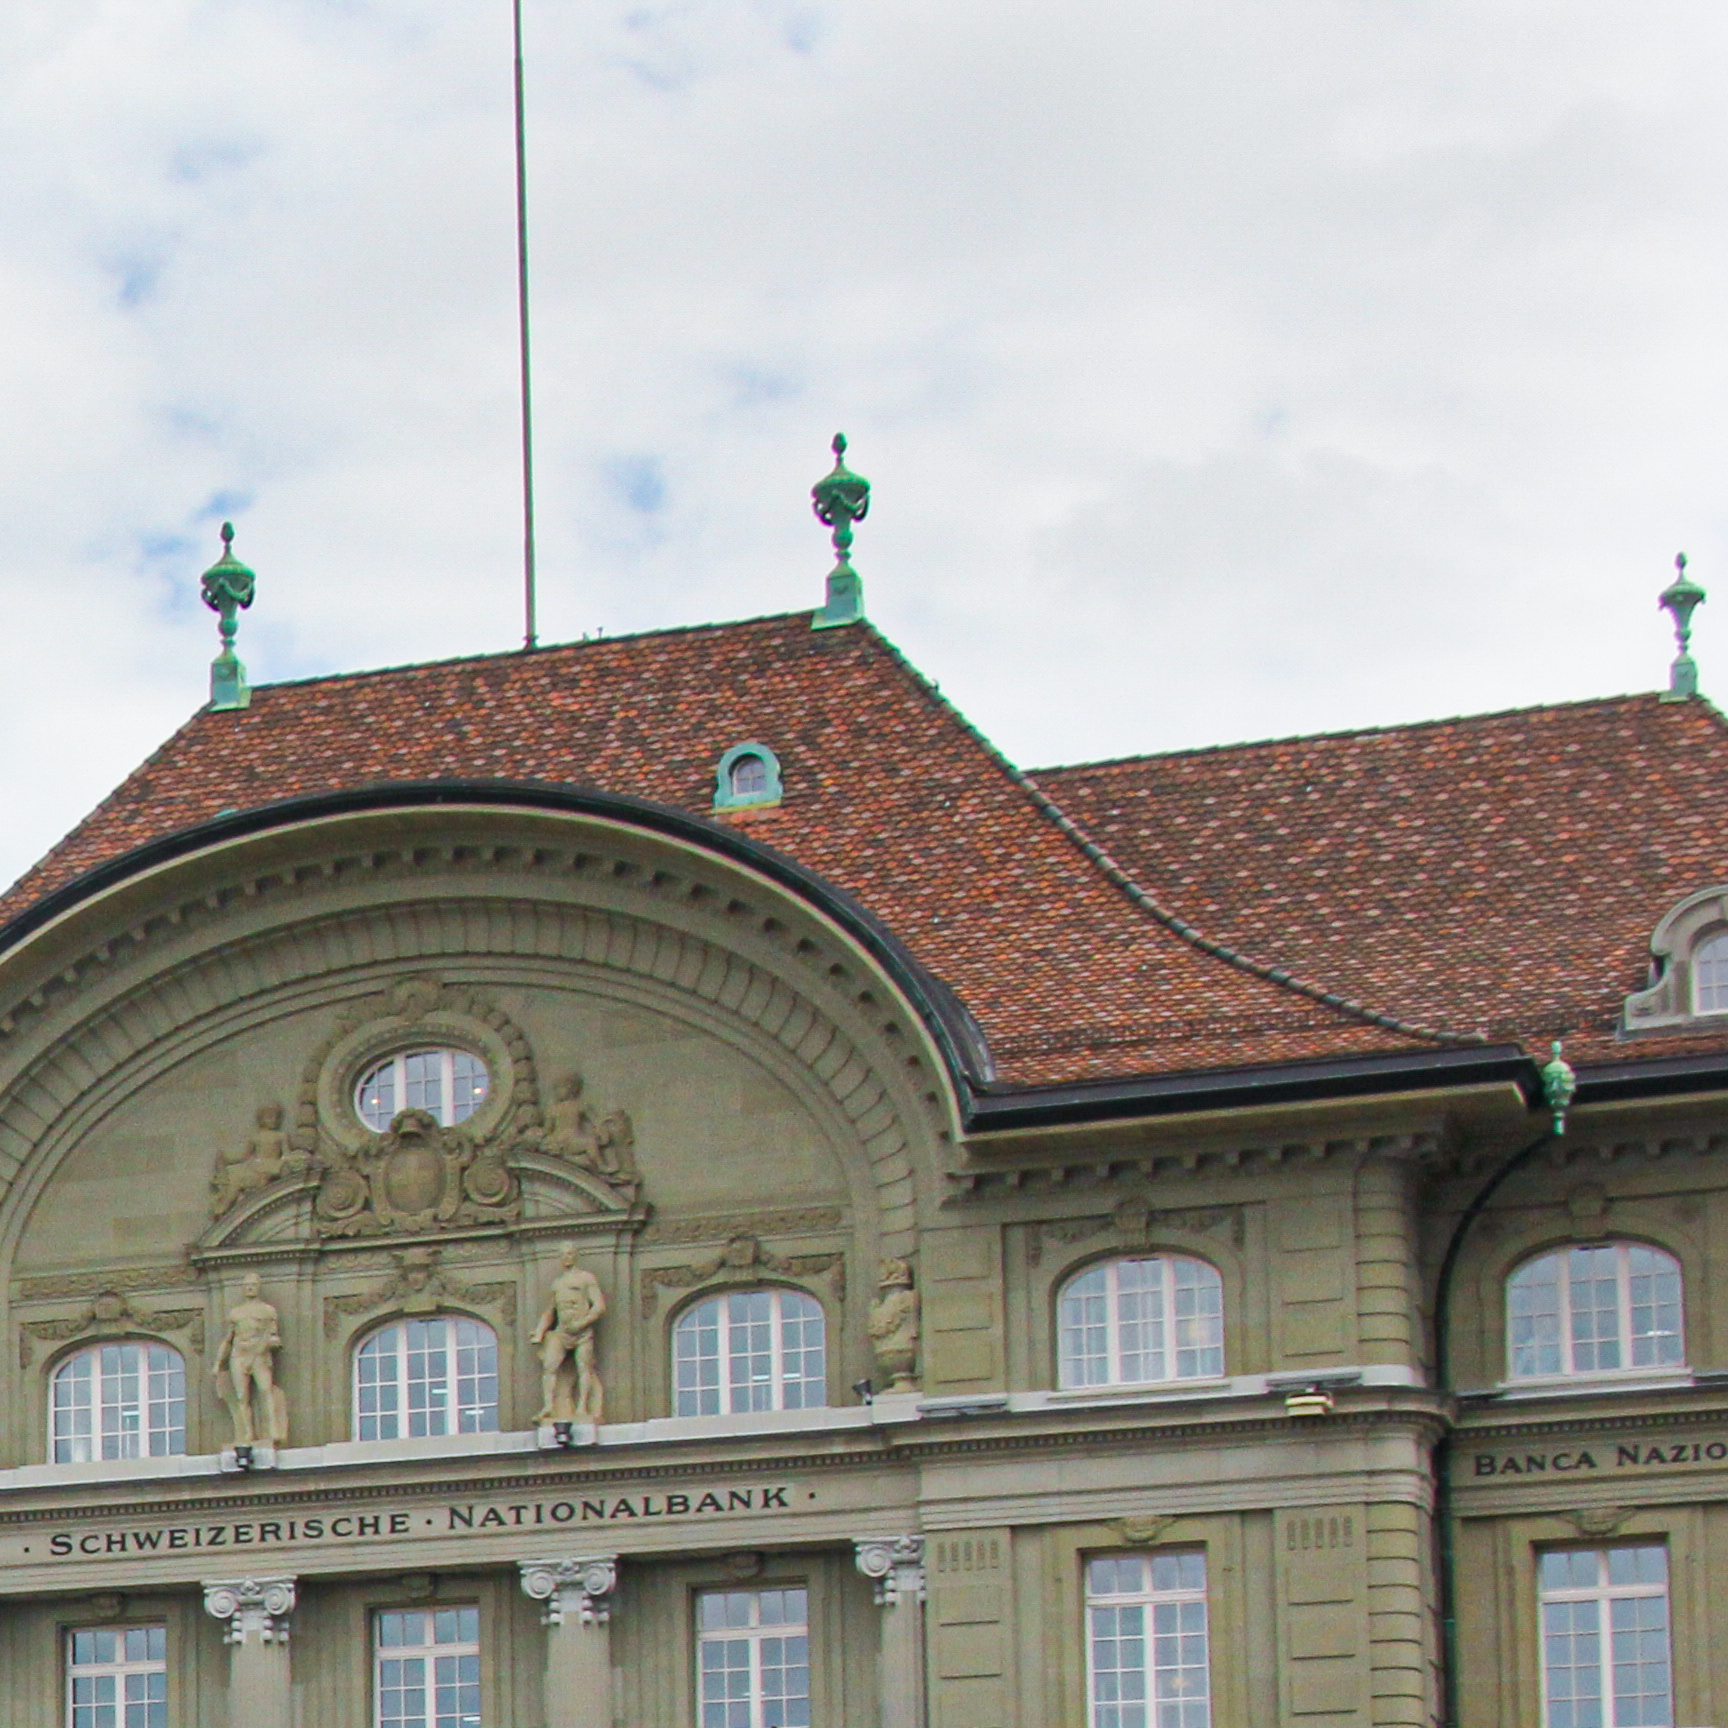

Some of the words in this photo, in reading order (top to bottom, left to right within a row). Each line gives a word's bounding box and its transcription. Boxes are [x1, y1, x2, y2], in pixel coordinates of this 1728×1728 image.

[1473, 1450, 1598, 1477] BANCA
[49, 1513, 411, 1556] SCHWEIZERISCHE
[447, 1487, 789, 1530] NATIONALBANK
